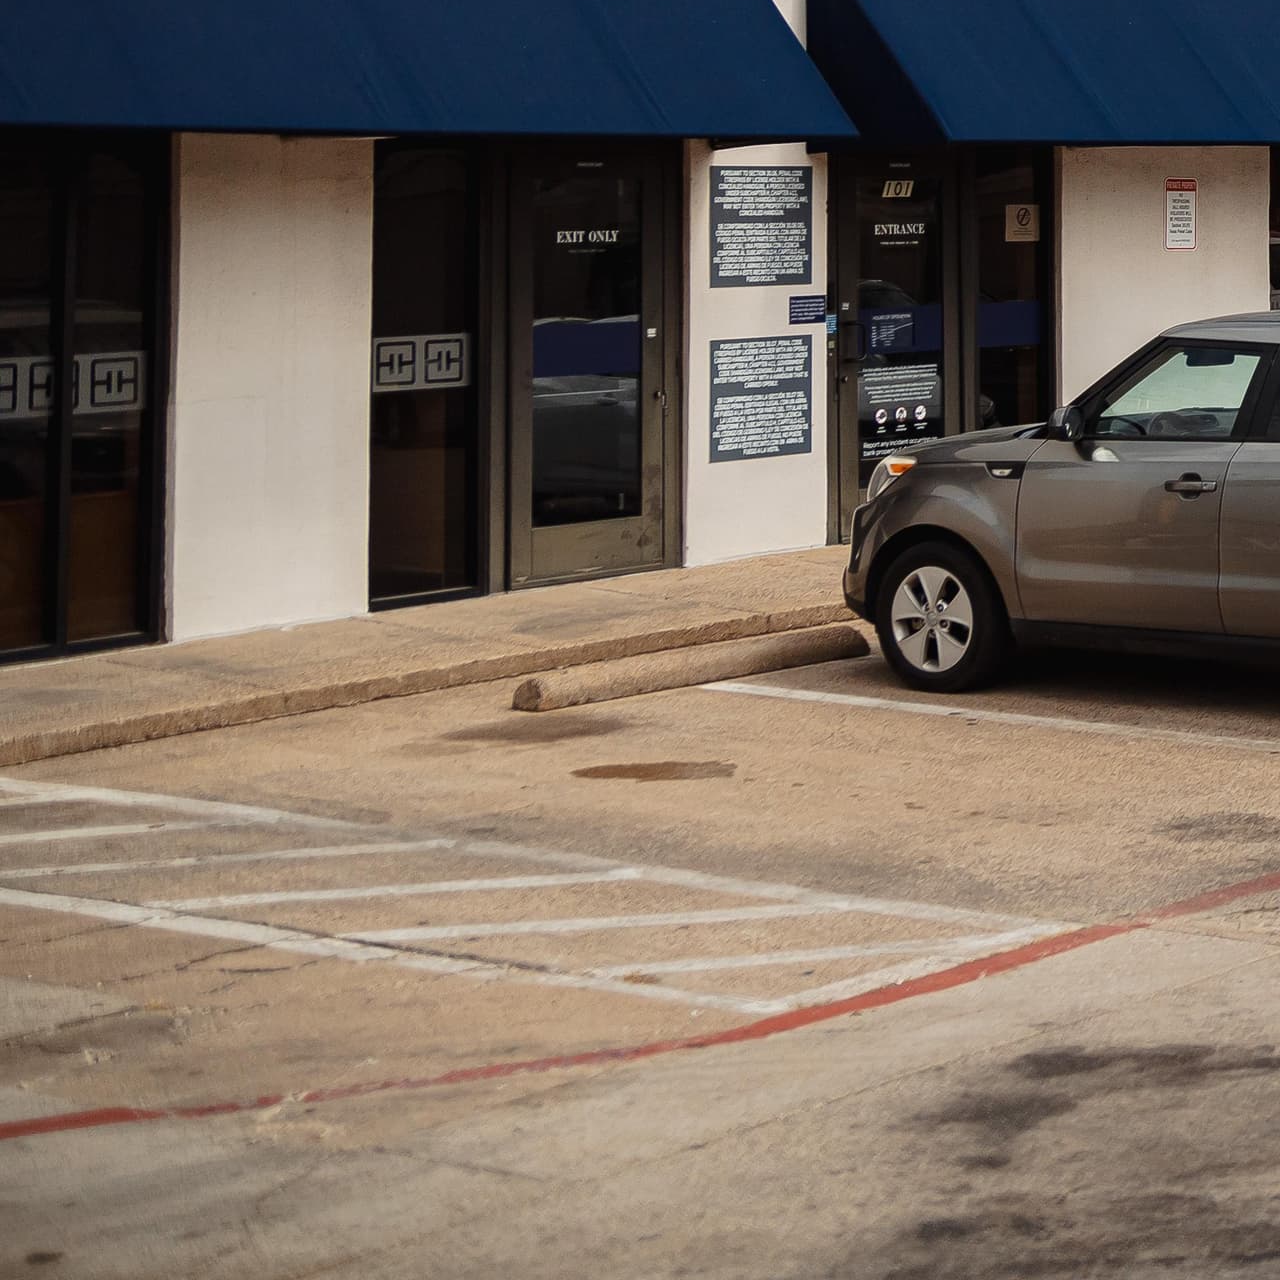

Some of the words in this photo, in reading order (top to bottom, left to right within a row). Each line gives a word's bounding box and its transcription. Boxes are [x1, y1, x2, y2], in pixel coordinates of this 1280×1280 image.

[874, 223, 925, 236] ENTRANCE
[557, 231, 585, 244] EXIT
[588, 230, 619, 242] ONLY
